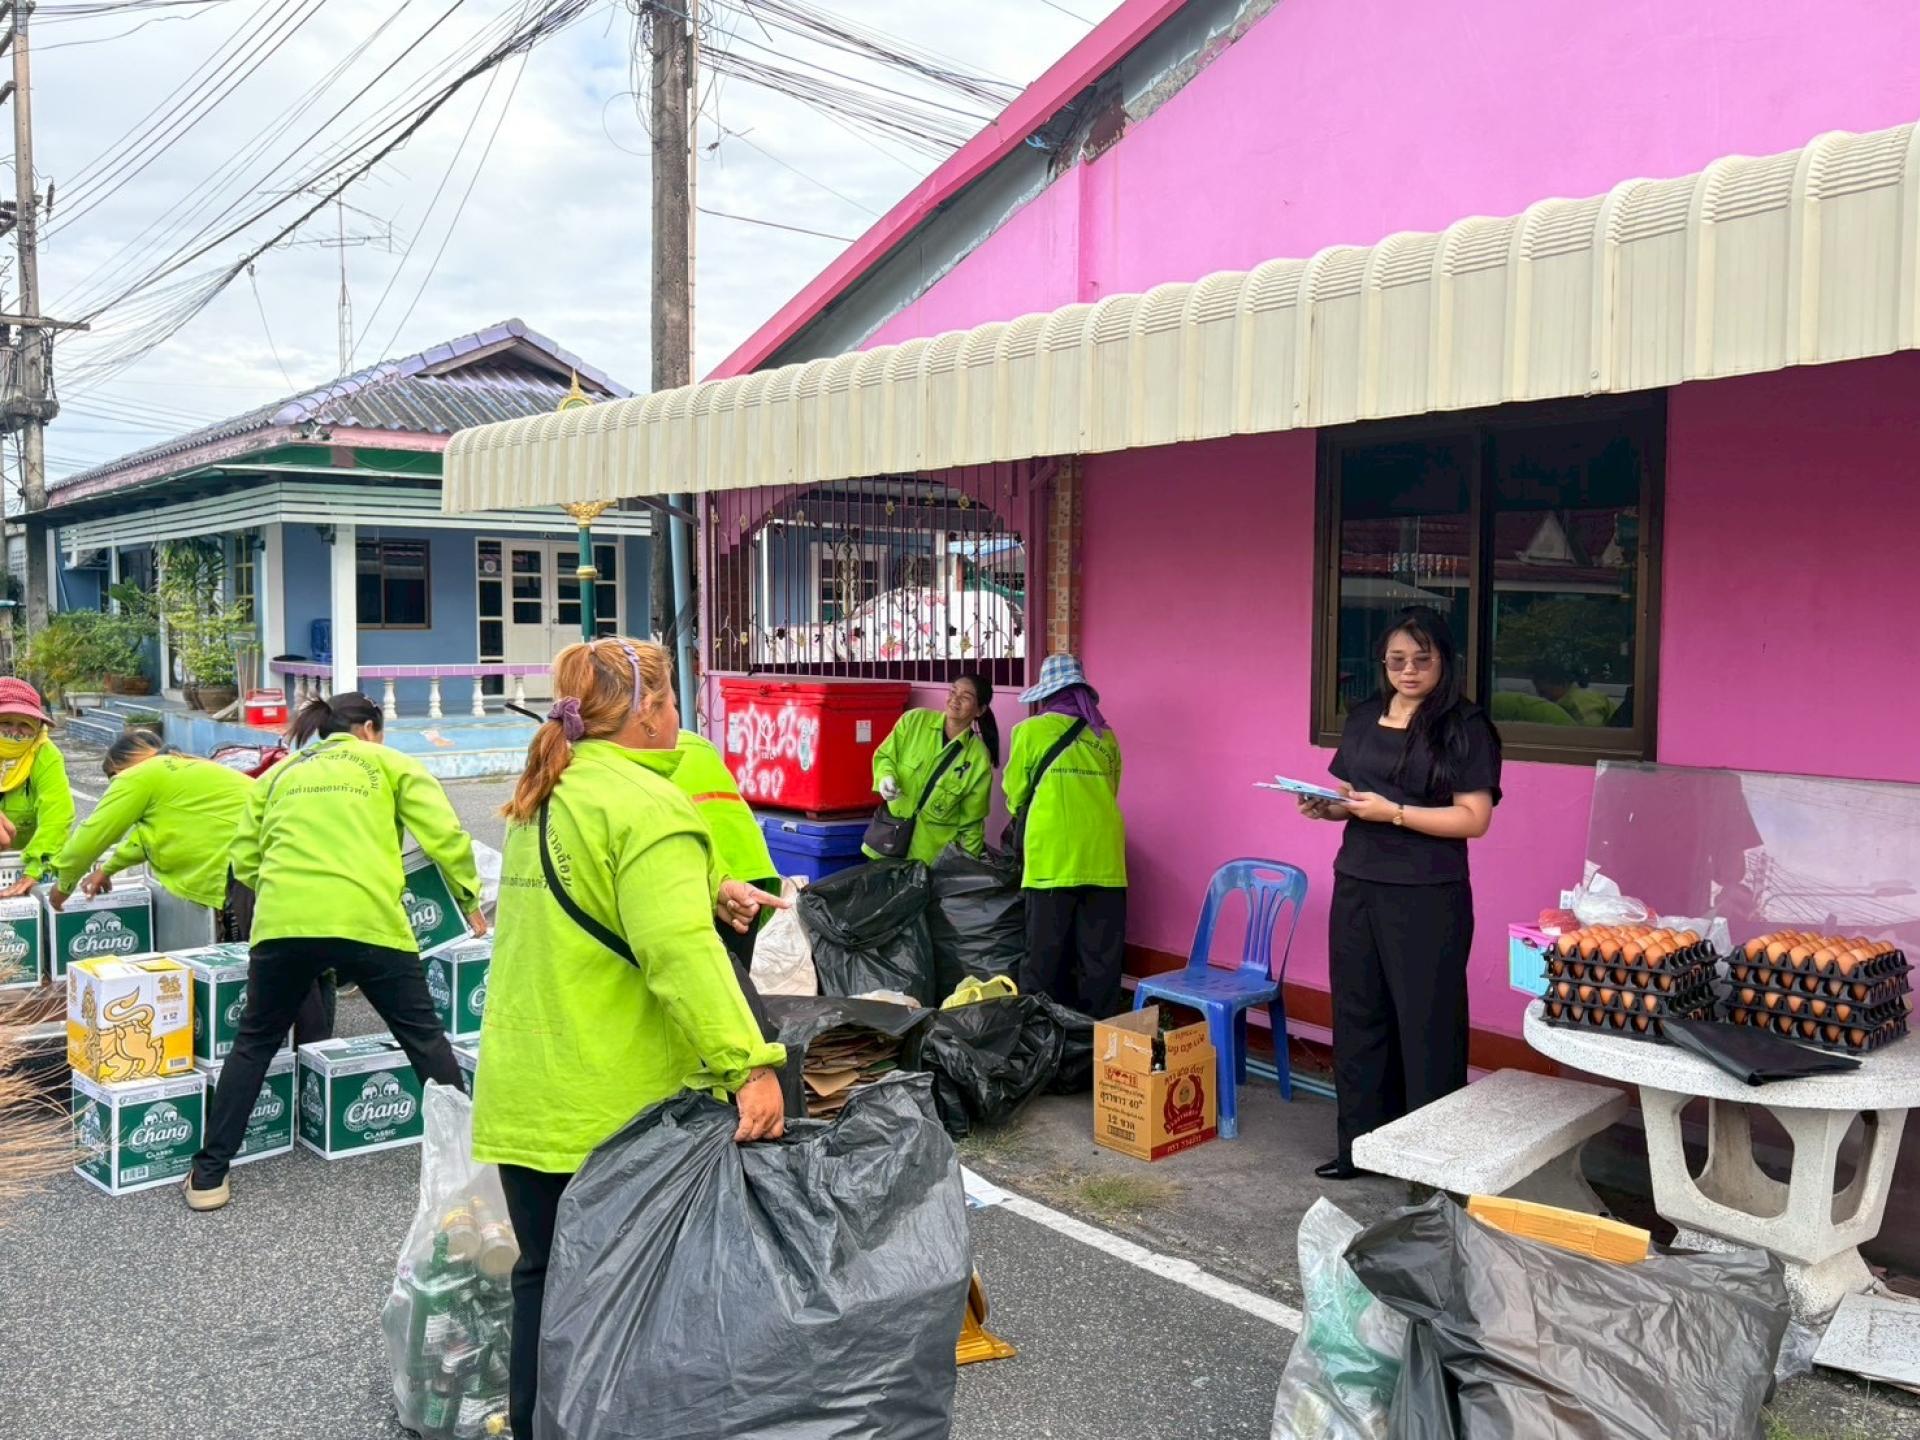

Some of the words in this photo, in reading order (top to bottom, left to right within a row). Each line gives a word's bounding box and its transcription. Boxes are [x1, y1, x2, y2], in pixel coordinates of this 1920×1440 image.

[0, 940, 26, 954] ang
[72, 935, 134, 953] Chang
[428, 984, 450, 1005] hang
[248, 1102, 281, 1118] ang
[347, 1100, 411, 1123] Chang
[131, 1124, 188, 1146] Chang
[363, 1128, 396, 1140] CLASSIC
